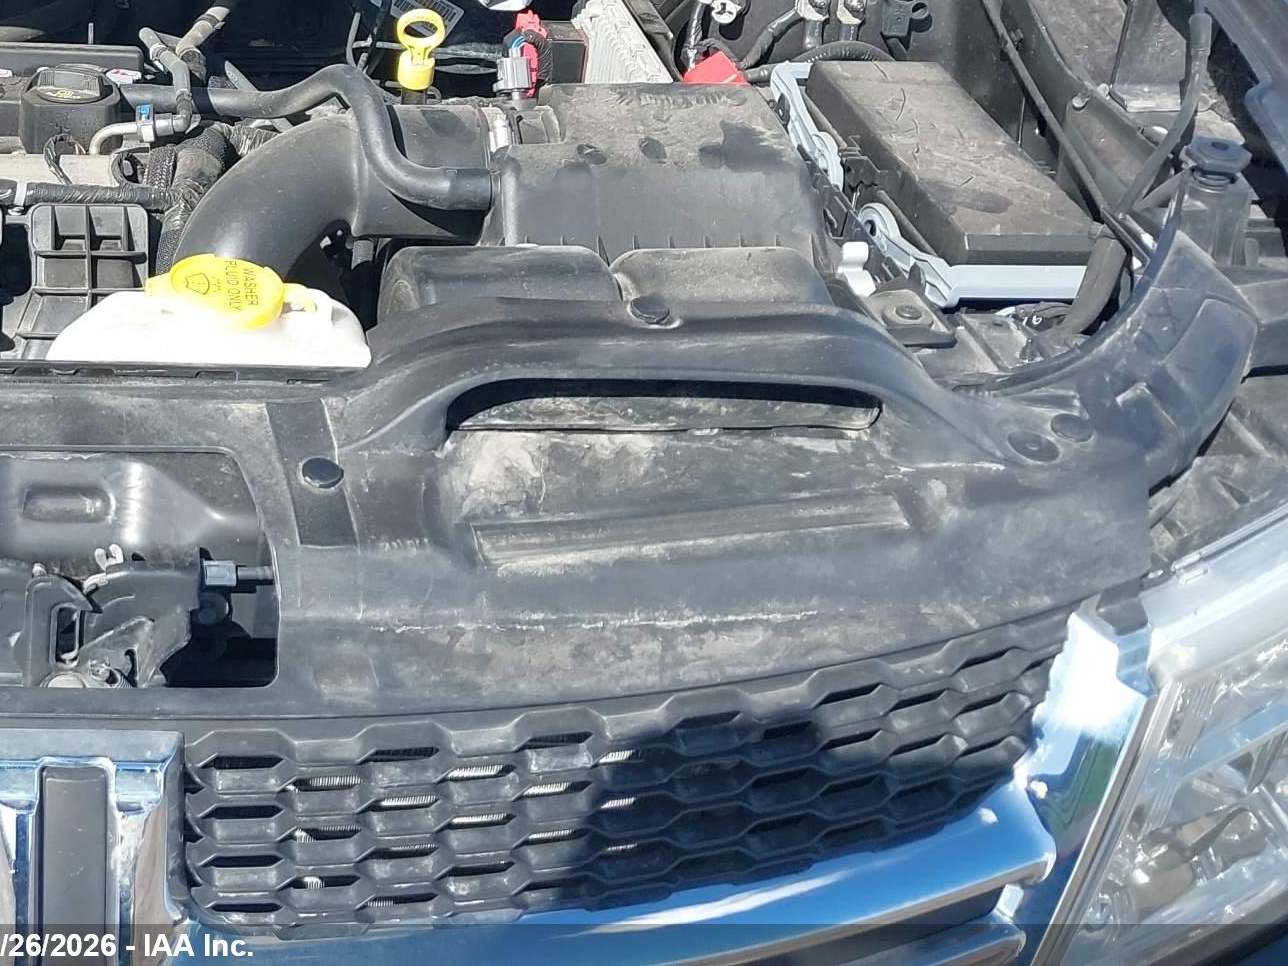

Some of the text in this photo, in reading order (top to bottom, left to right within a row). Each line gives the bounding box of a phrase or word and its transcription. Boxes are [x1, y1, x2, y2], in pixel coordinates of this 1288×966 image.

[224, 260, 242, 311] FLUID ONLY
[241, 267, 260, 306] WASHER
